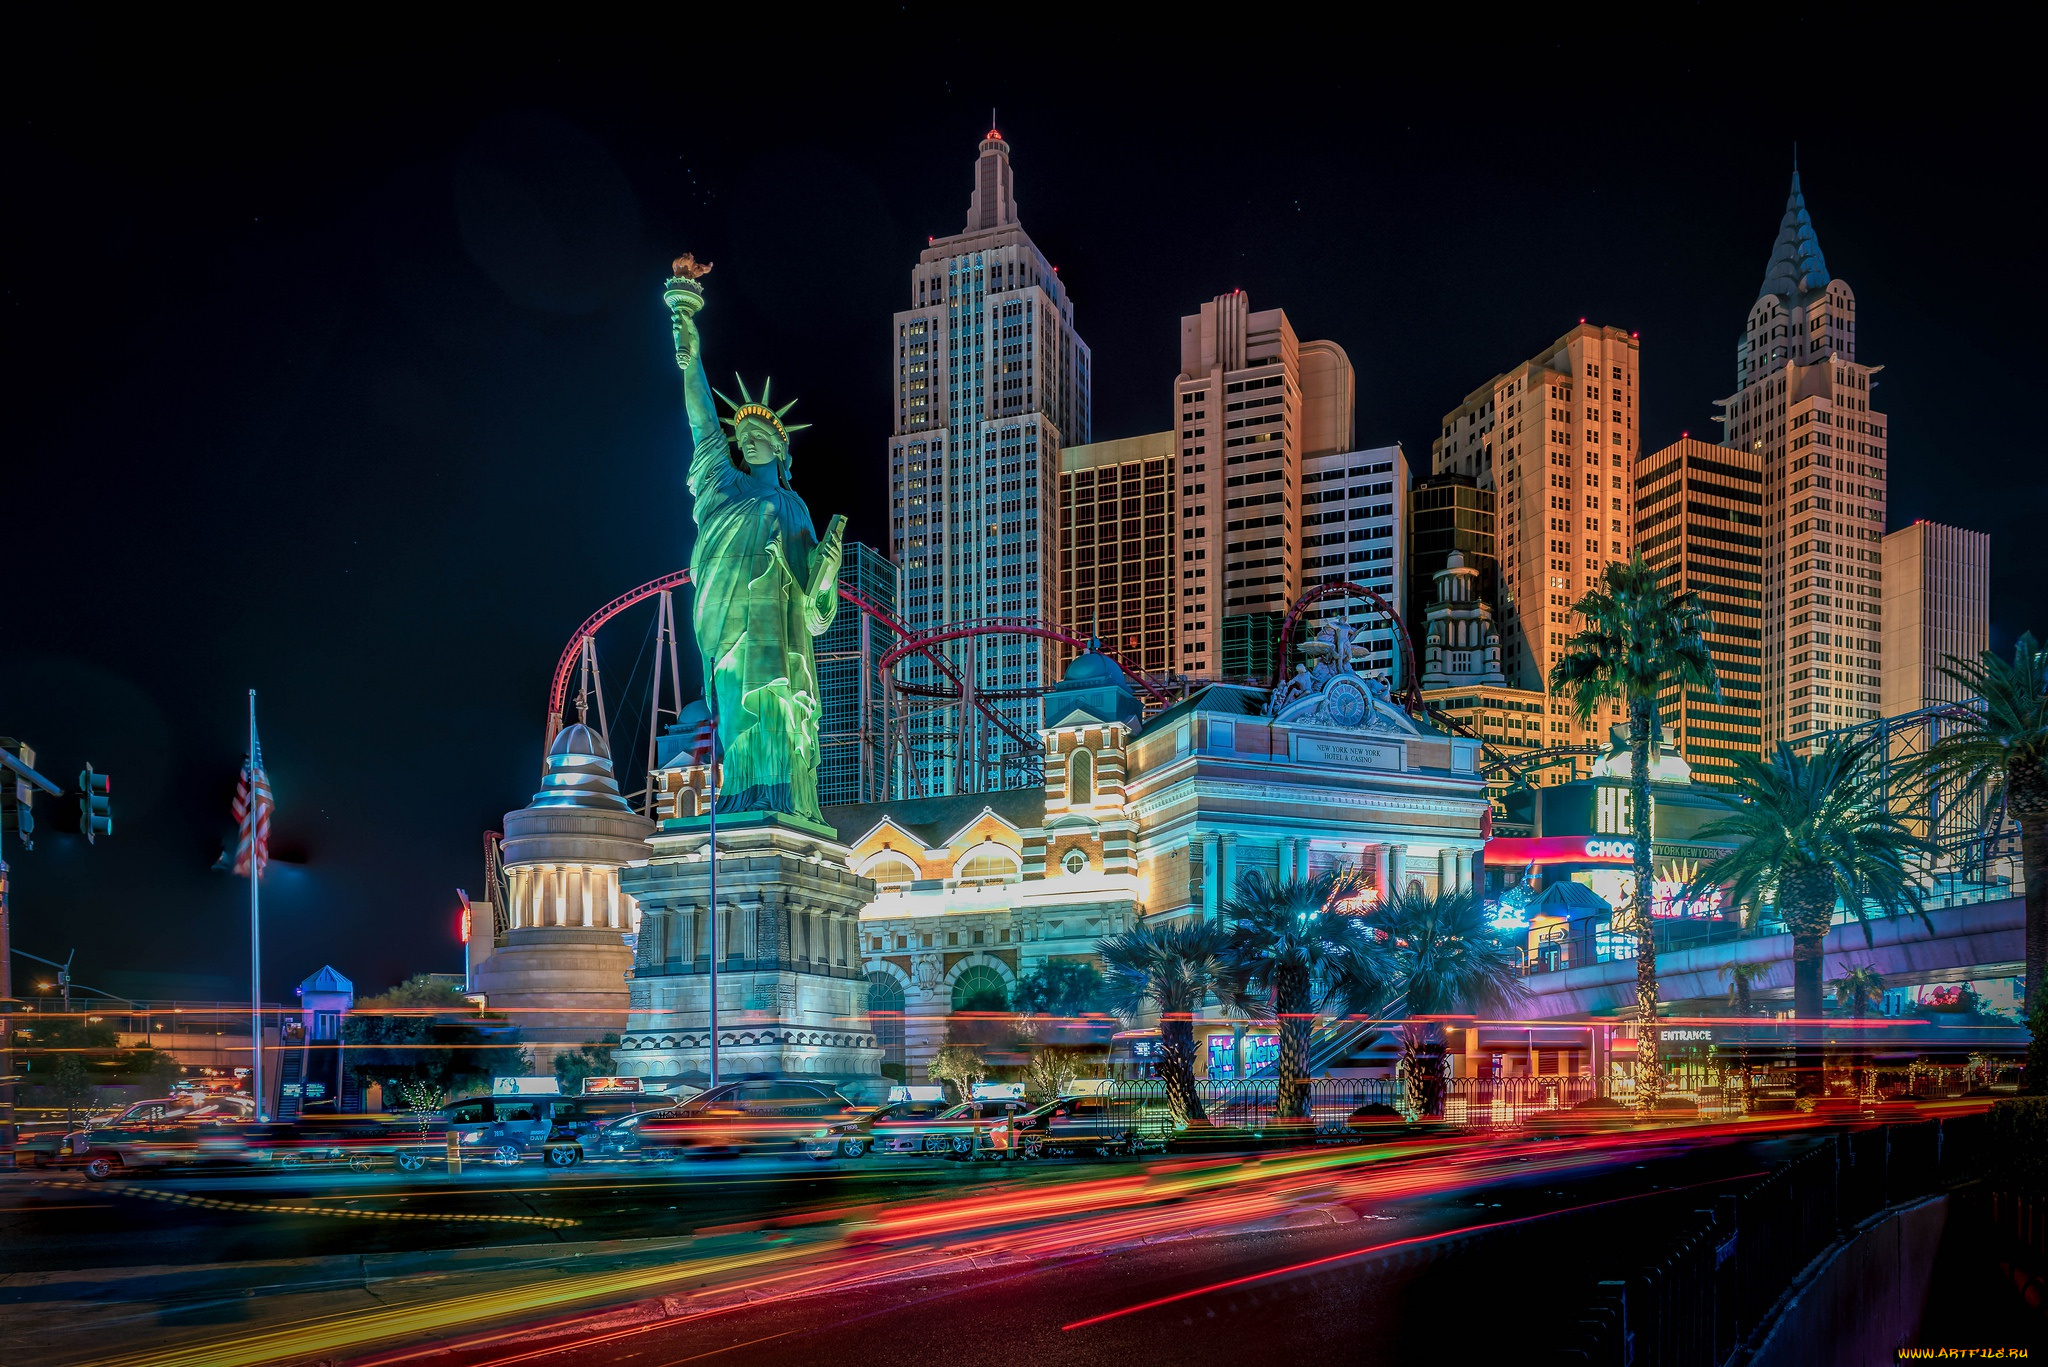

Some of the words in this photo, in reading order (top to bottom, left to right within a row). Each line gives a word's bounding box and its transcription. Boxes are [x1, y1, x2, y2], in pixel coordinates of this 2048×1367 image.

[1316, 744, 1331, 752] NEW
[1332, 745, 1348, 754] YORK
[1349, 747, 1364, 755] NEW
[1365, 749, 1381, 757] YORK
[1324, 752, 1342, 761] HOTEL
[1350, 755, 1372, 763] CASINO
[1585, 840, 1636, 858] CHOC
[1681, 847, 1699, 858] NEW
[1698, 848, 1719, 859] YORK
[1660, 1030, 1712, 1041] ENTRANCE
